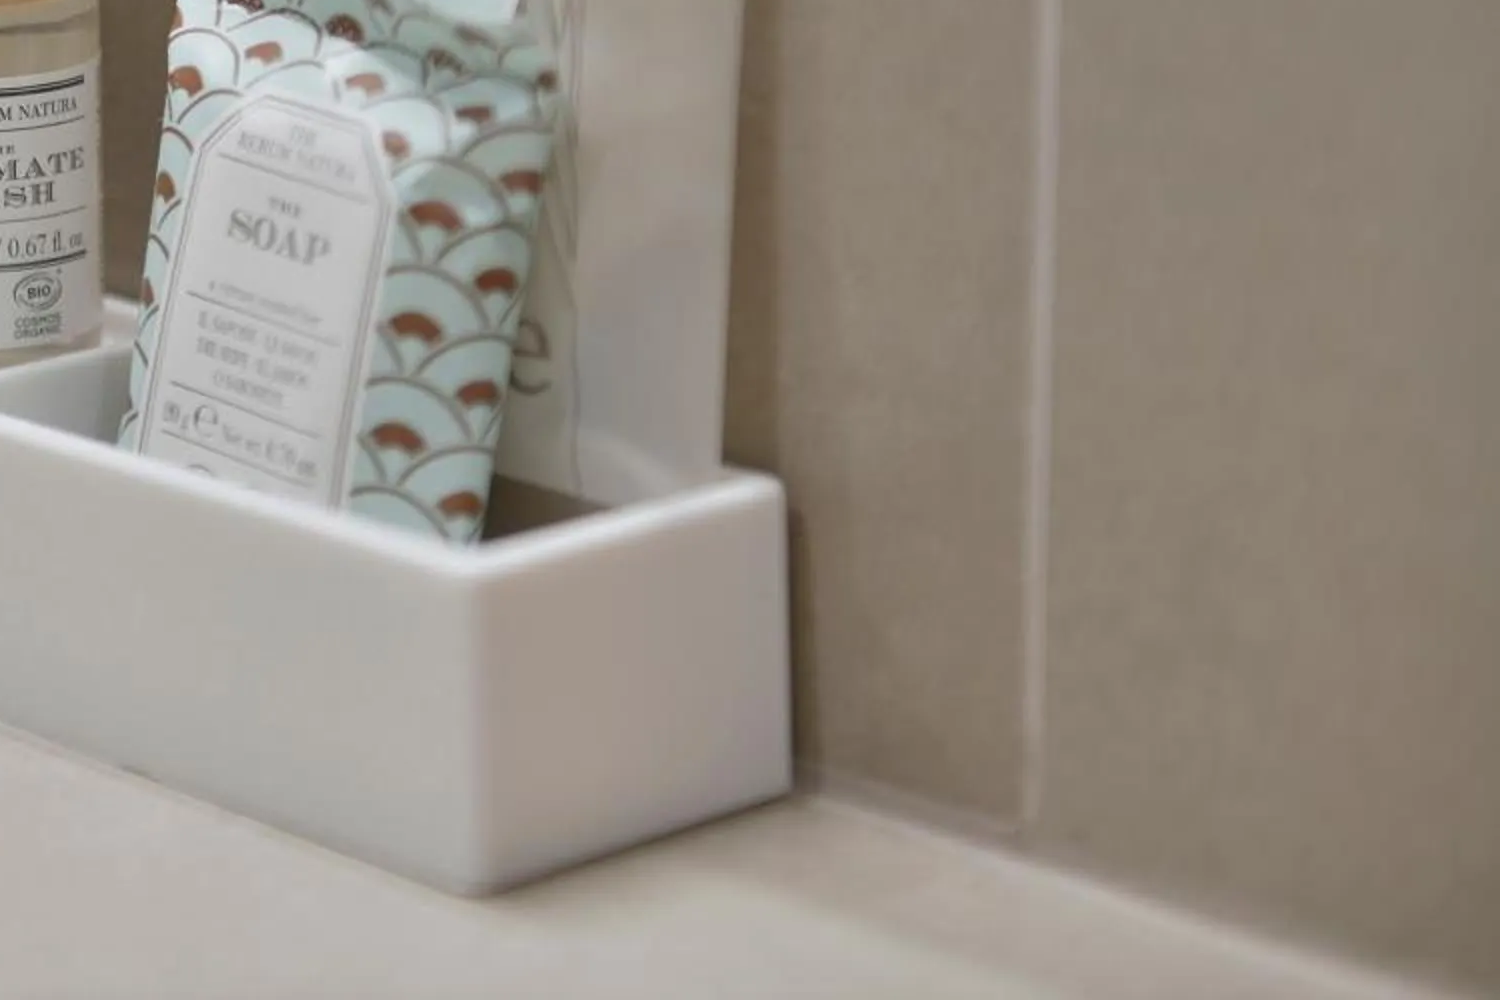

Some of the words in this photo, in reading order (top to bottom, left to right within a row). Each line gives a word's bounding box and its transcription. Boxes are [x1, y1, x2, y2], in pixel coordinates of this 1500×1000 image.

[18, 97, 78, 121] NATURA
[8, 233, 47, 259] 0.67
[226, 206, 332, 267] SOAP
[27, 284, 51, 300] BIO
